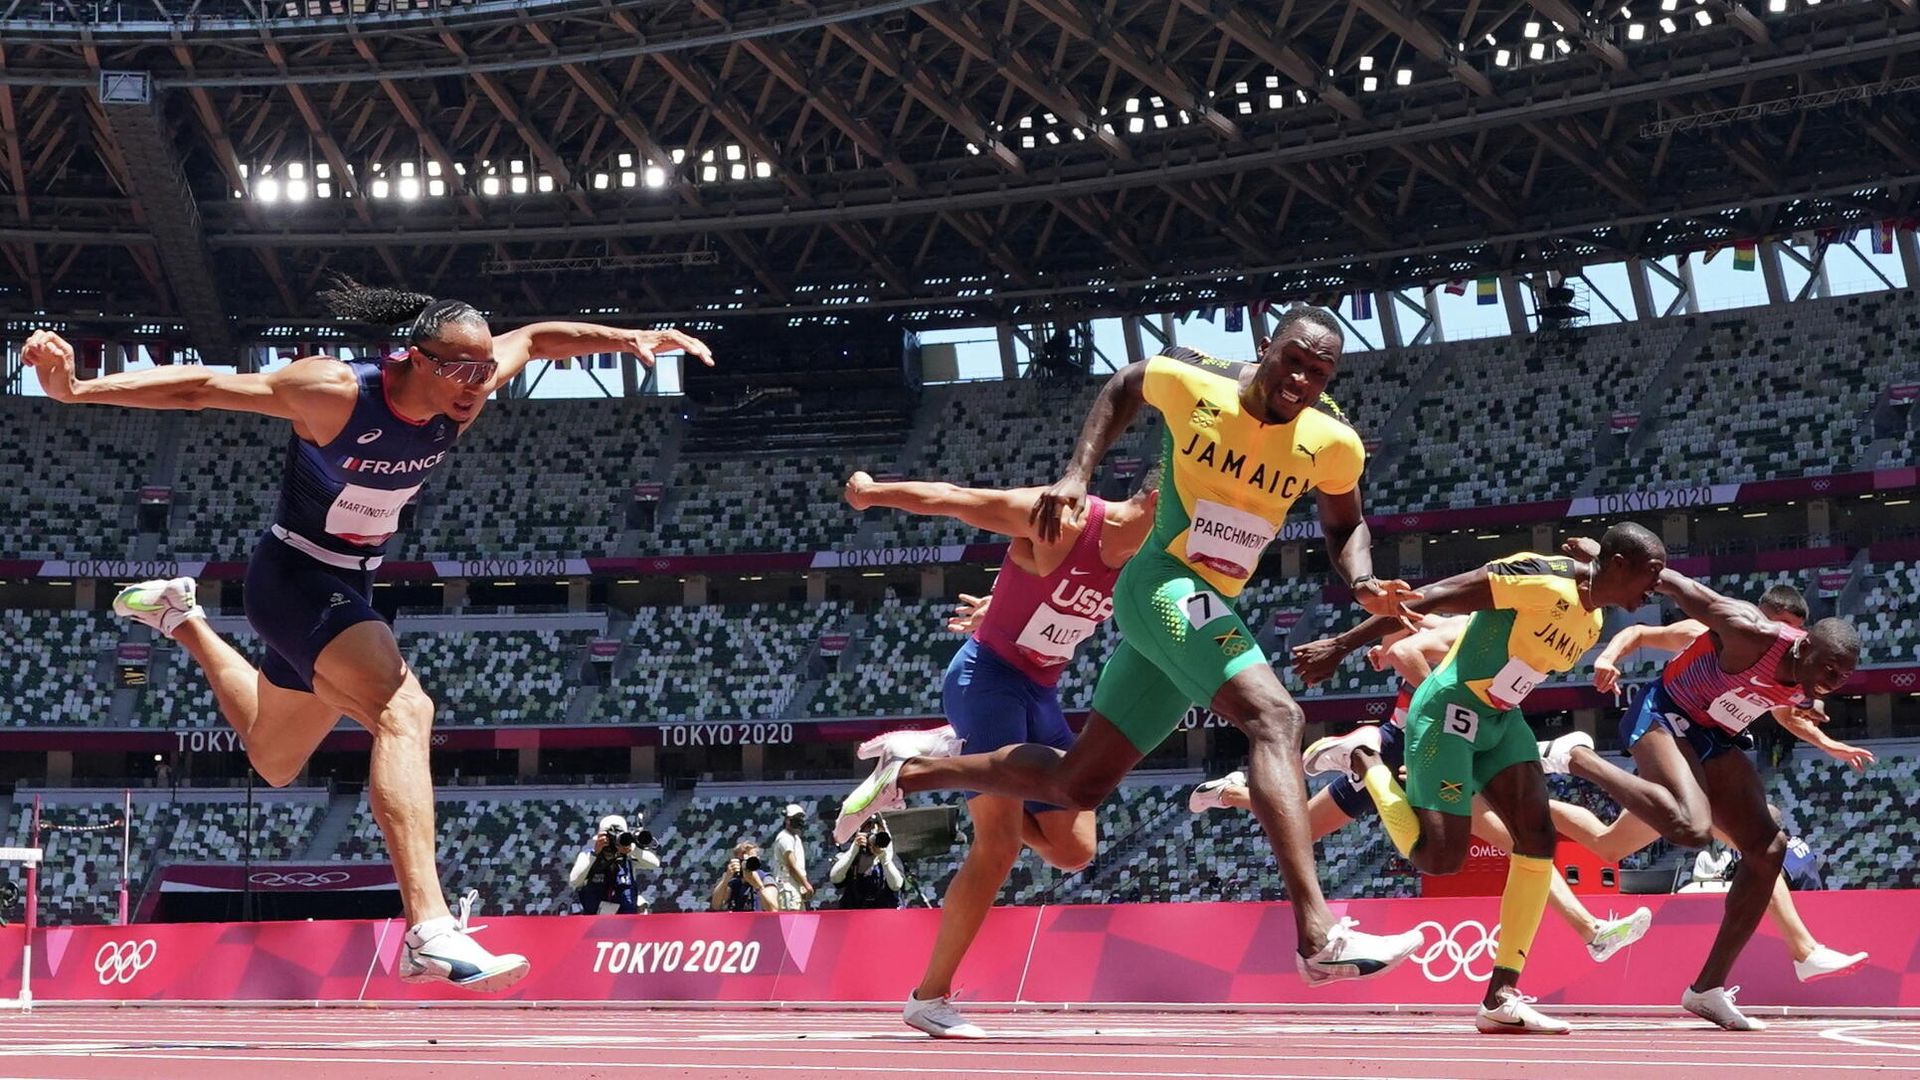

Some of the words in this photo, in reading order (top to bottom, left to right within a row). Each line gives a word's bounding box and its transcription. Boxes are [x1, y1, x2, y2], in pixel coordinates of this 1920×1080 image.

[357, 450, 446, 475] FRANCE
[1182, 434, 1310, 499] JAMAICA
[1593, 491, 1659, 515] TOKYO
[1664, 486, 1712, 509] 2020
[1193, 517, 1269, 549] PARCHMENT
[1283, 521, 1315, 540] 020
[67, 560, 128, 577] TOKYO
[134, 560, 179, 577] 2020
[459, 560, 518, 577] TOKYO
[523, 558, 566, 576] 2020
[836, 548, 894, 568] TOKYO
[900, 546, 941, 565] 2020
[1051, 578, 1114, 621] USA
[1187, 592, 1211, 620] 7
[1534, 623, 1583, 663] JAMAI
[1452, 709, 1472, 734] 5
[1719, 699, 1755, 724] HOLLO
[658, 724, 733, 746] TOKYO
[738, 723, 793, 745] 2020
[593, 940, 684, 974] TOKYO
[683, 939, 761, 974] 2020
